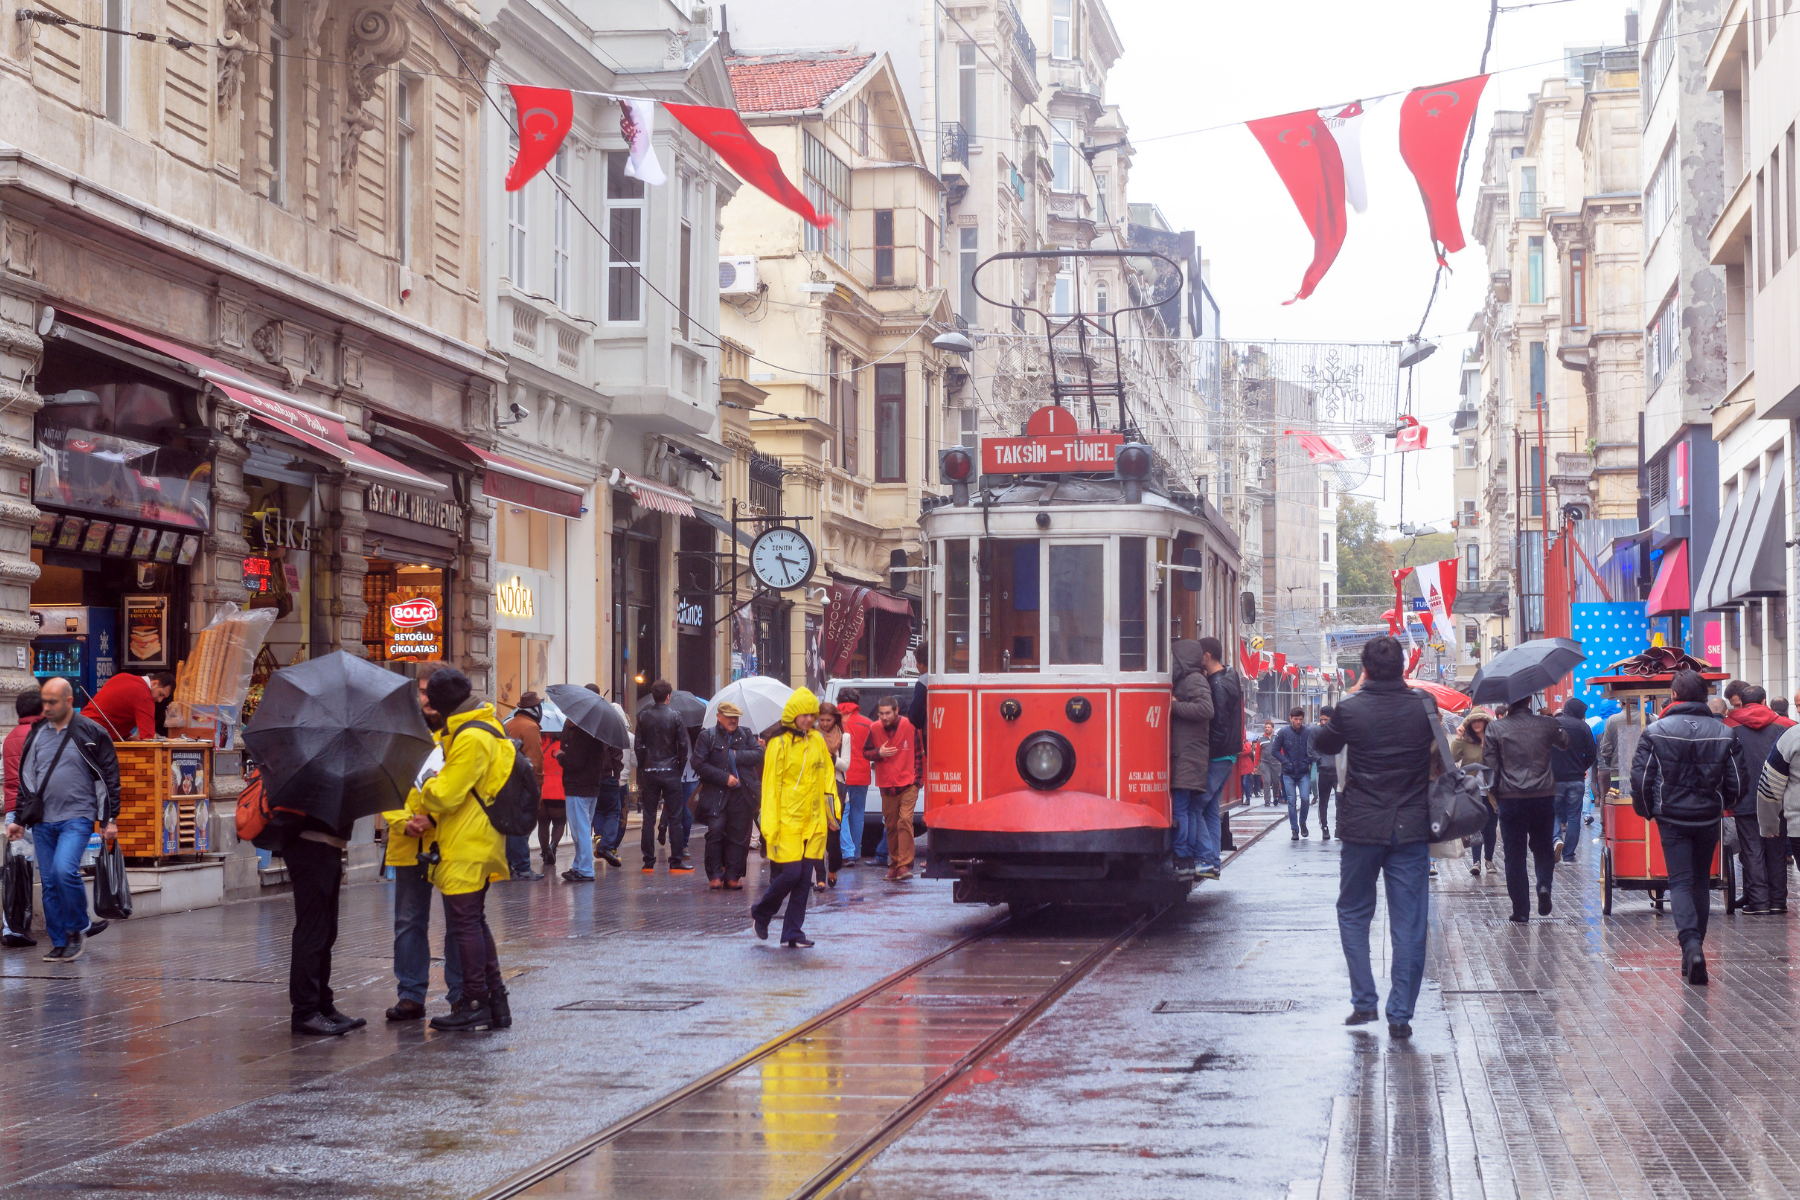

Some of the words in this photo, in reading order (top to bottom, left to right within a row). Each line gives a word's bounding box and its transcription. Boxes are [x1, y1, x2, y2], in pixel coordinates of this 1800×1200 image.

[1048, 409, 1055, 433] 1
[994, 441, 1047, 464] TAKSİM
[394, 631, 434, 641] BEYOĞLU
[390, 643, 438, 655] ÇİKOLATASI
[1423, 663, 1457, 674] SHKE
[932, 707, 945, 729] 47
[1146, 706, 1161, 728] 47
